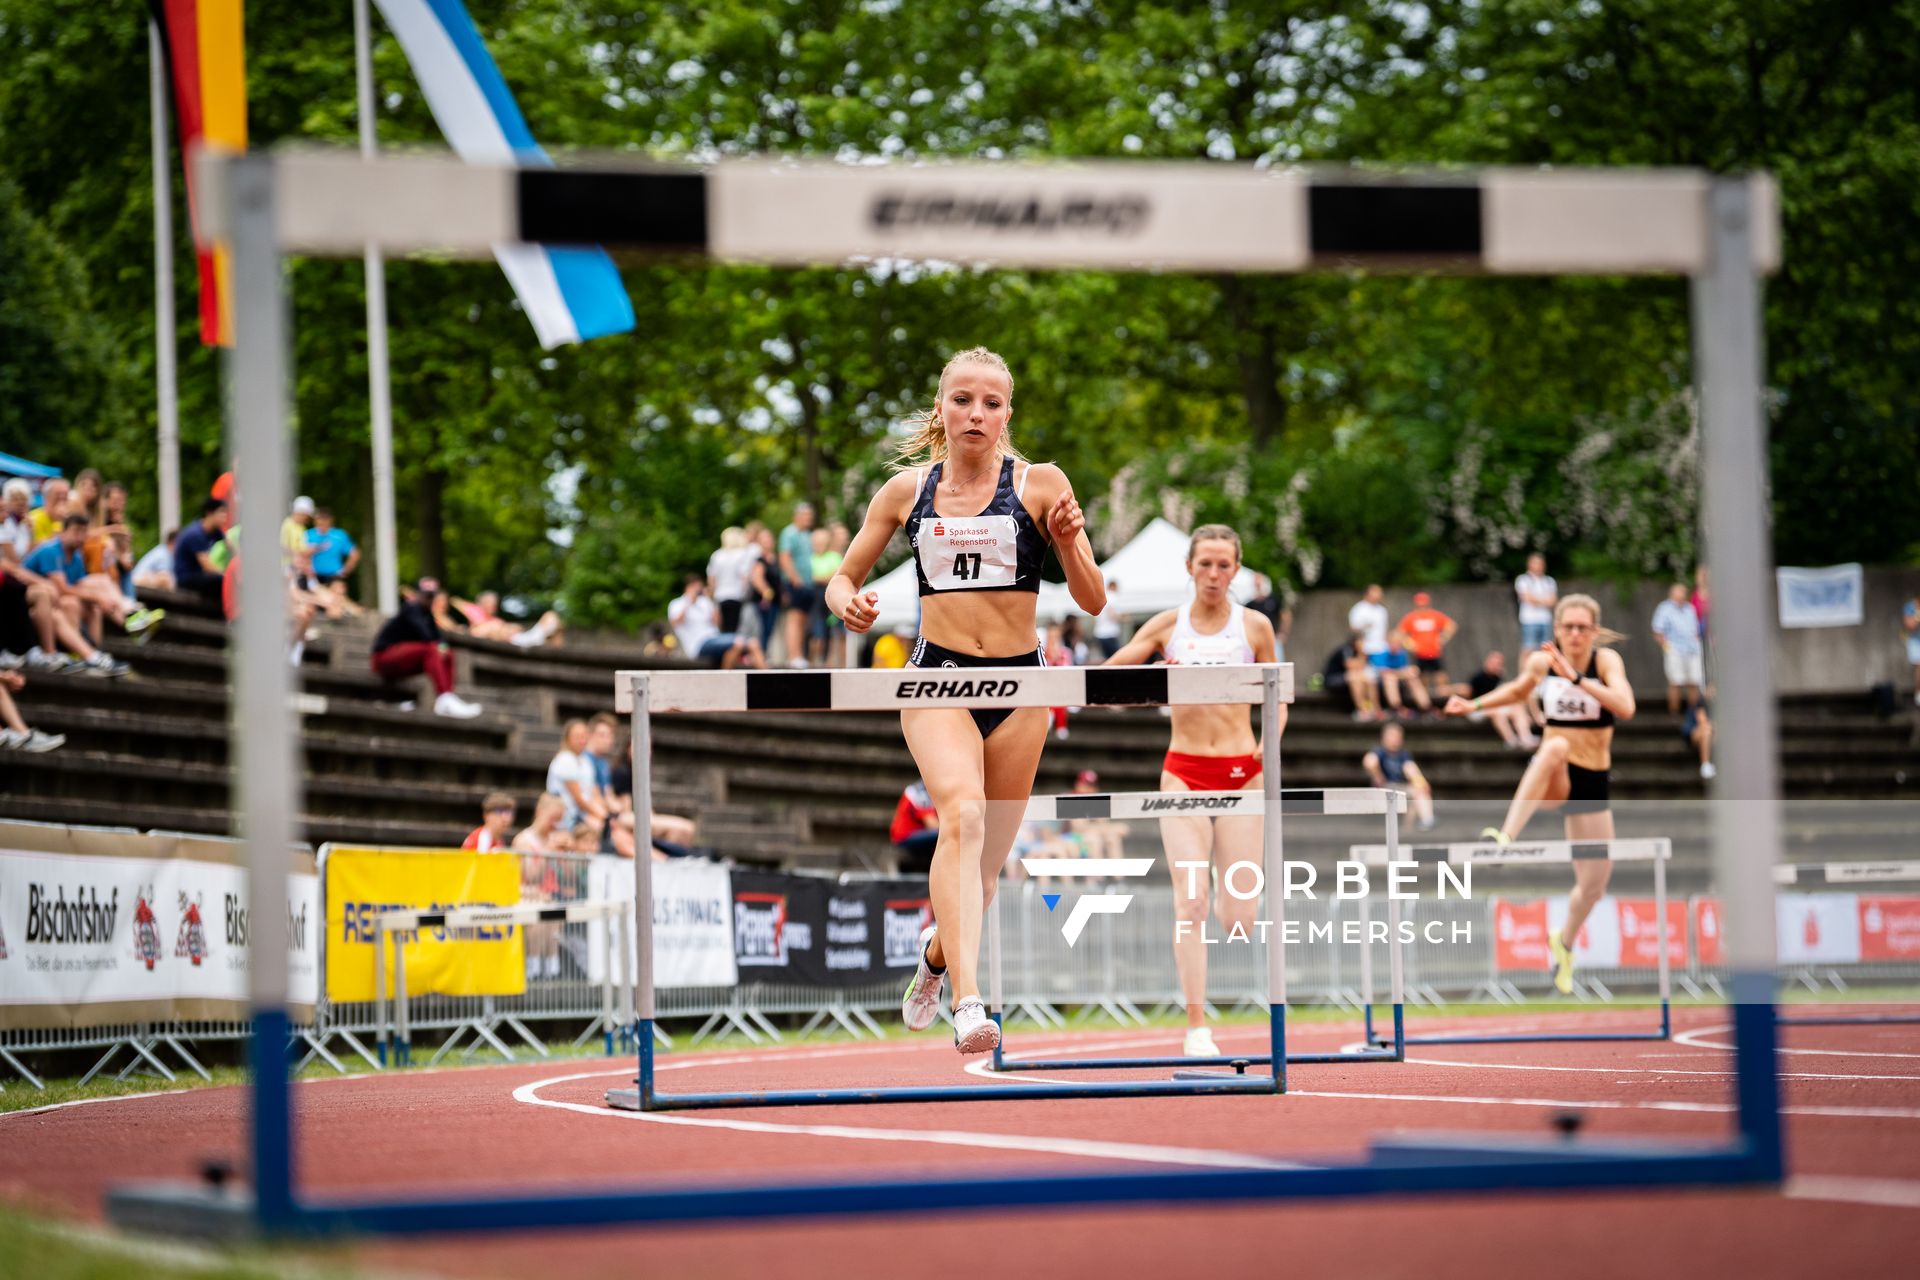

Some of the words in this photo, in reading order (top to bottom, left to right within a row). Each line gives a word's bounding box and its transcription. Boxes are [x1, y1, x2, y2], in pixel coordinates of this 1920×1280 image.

[949, 527, 989, 537] Sparkasse
[949, 537, 998, 547] Regensburg
[952, 552, 982, 581] 47
[895, 680, 1019, 699] ERHARD
[1140, 796, 1243, 812] UNI-SPORT
[26, 882, 118, 944] Bischofshof
